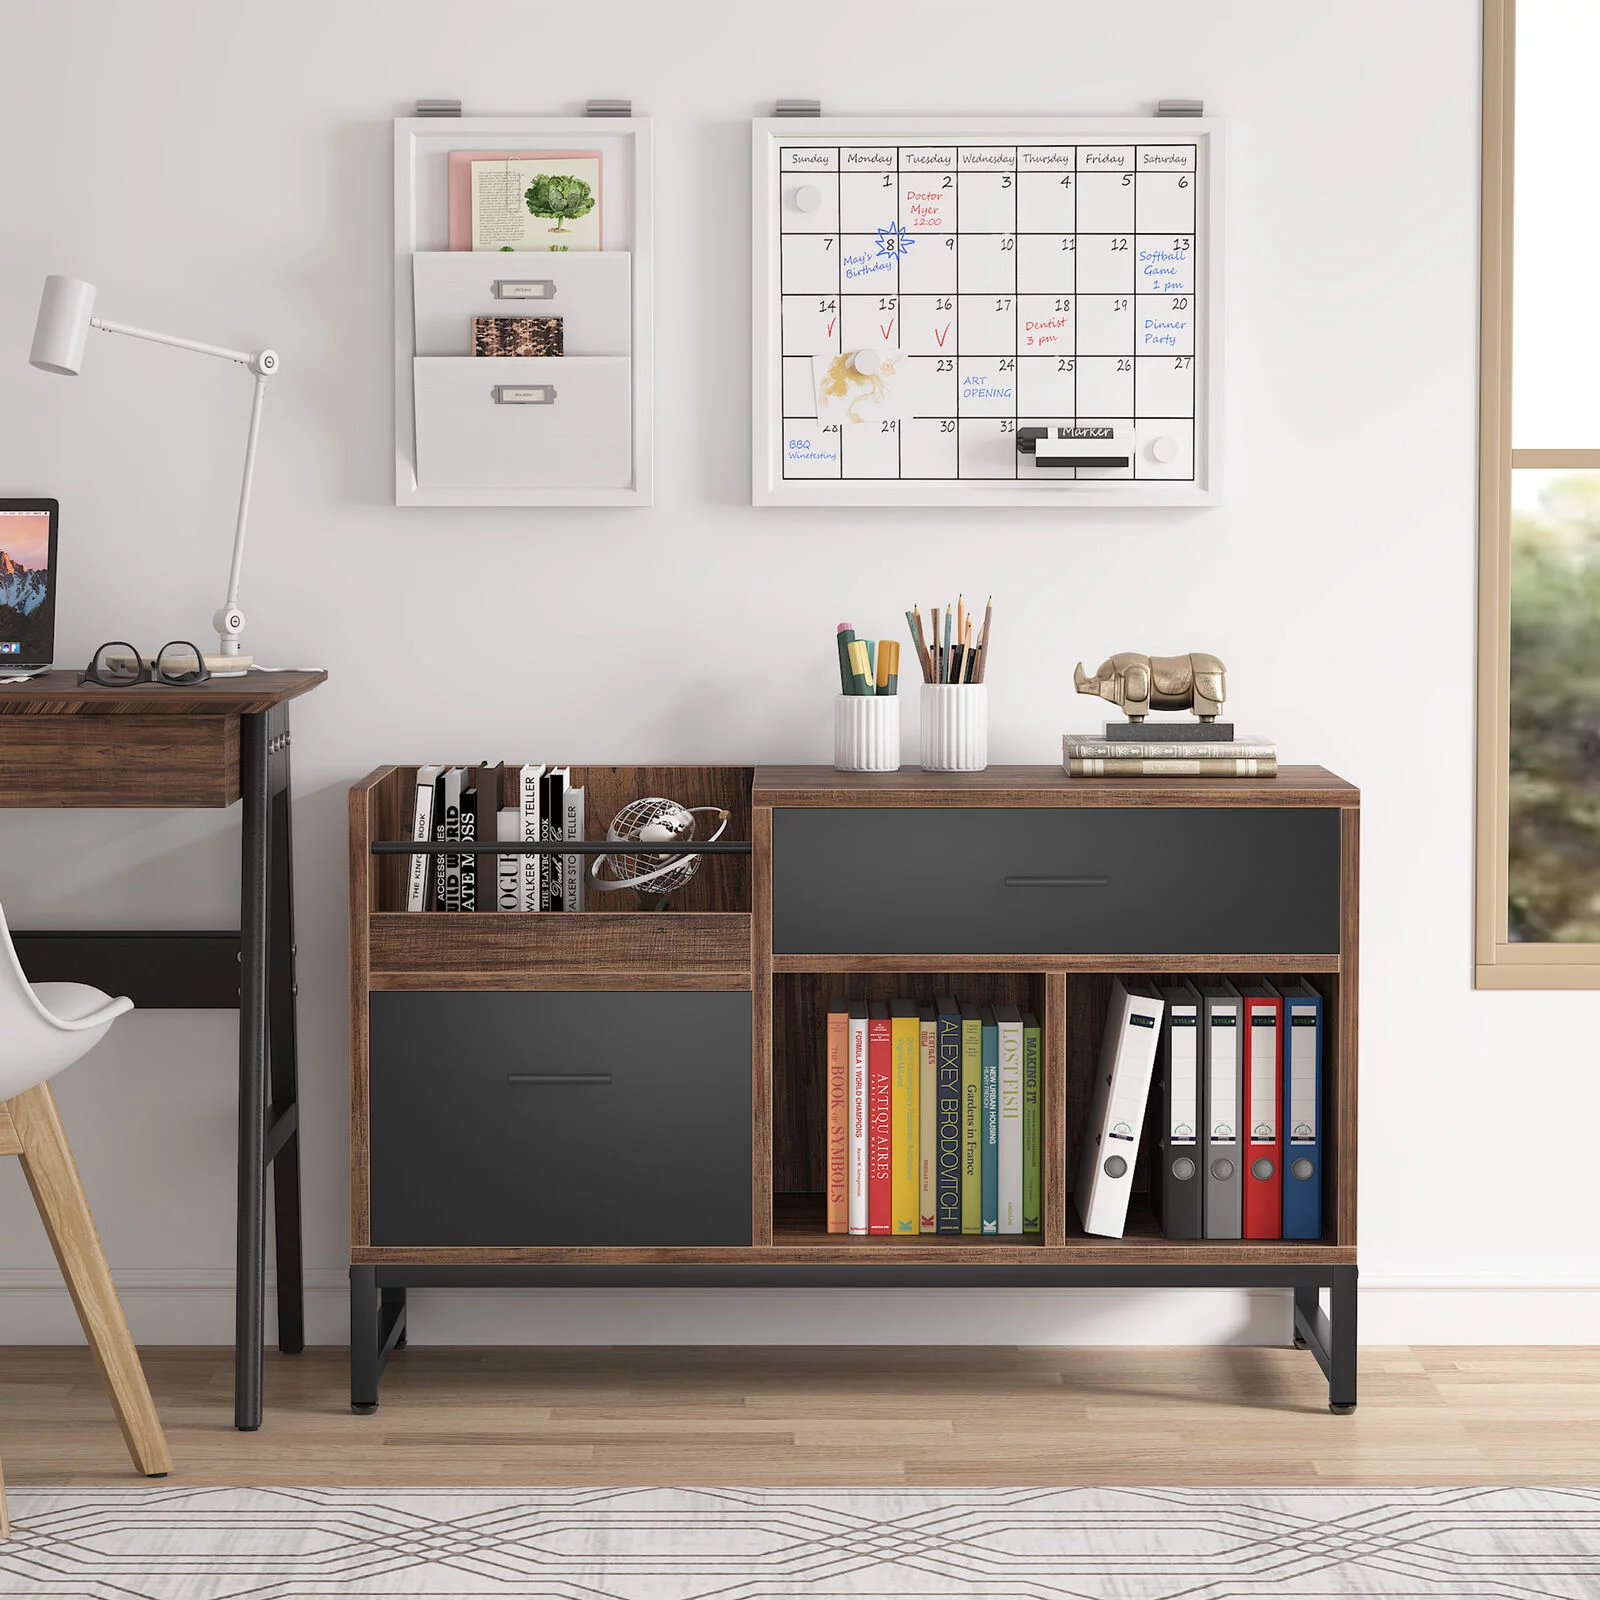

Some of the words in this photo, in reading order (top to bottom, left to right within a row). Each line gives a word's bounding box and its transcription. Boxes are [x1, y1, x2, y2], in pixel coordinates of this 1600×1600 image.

[792, 153, 829, 166] Sunday
[847, 154, 892, 166] Monday
[906, 154, 951, 166] Tuesday
[962, 153, 1015, 166] Wednesday
[1023, 153, 1069, 165] Thursday
[1085, 153, 1125, 166] Friday
[1143, 154, 1187, 165] Saturday
[882, 175, 892, 187] 1
[942, 176, 953, 188] 2
[1001, 176, 1012, 188] 3
[1060, 175, 1071, 188] 4
[1121, 175, 1132, 186] 5
[1178, 176, 1188, 188] 6
[907, 191, 943, 202] Doctor
[911, 204, 939, 217] Myer
[913, 218, 942, 226] 12:00
[824, 239, 833, 251] 7
[886, 239, 895, 251] 8
[945, 239, 954, 251] 9
[1001, 239, 1013, 252] 10
[1061, 239, 1076, 251] 11
[1111, 239, 1128, 251] 12
[1174, 239, 1190, 251] 13
[843, 252, 872, 267] May's
[1139, 251, 1186, 262] Softball
[846, 260, 892, 279] Birthday
[1144, 265, 1177, 277] Game
[1152, 280, 1160, 290] 1
[1164, 280, 1184, 291] pm
[819, 300, 836, 312] 14
[879, 299, 897, 311] 15
[936, 299, 952, 310] 16
[996, 300, 1011, 311] 17
[1055, 299, 1070, 311] 18
[1114, 299, 1128, 311] 19
[1172, 298, 1188, 310] 20
[1025, 318, 1066, 330] Dentist
[1145, 319, 1186, 330] Dinner
[1026, 335, 1034, 346] 3
[1037, 334, 1058, 346] pm
[1145, 333, 1176, 346] Party
[936, 360, 953, 372] 23
[999, 360, 1015, 372] 24
[1058, 360, 1074, 372] 25
[1117, 359, 1131, 373] 26
[1175, 357, 1191, 370] 27
[963, 377, 987, 386] ART
[963, 389, 1011, 398] OPENING
[881, 420, 896, 433] 29
[940, 420, 956, 433] 30
[1000, 420, 1015, 433] 31
[1062, 428, 1111, 437] Marker
[789, 440, 811, 450] BBQ
[526, 776, 535, 816] TELLER
[418, 813, 426, 838] BOOK
[568, 806, 576, 839] TELLER
[447, 806, 459, 867] WRLD
[526, 820, 535, 859] SORY
[541, 854, 549, 888] PLAYBO
[461, 872, 474, 911] ATE
[568, 877, 577, 911] ALKER
[541, 890, 549, 908] THE
[940, 1020, 958, 1095] ALEXEY
[1003, 1028, 1018, 1075] LOST
[1027, 1037, 1036, 1088] MAKING
[831, 1066, 844, 1108] BOOK
[1003, 1080, 1018, 1118] FISH
[1027, 1091, 1036, 1104] IT
[968, 1084, 977, 1126] Gardens
[877, 1074, 888, 1180] ANTIQUAIRES
[968, 1130, 976, 1138] in
[831, 1126, 844, 1203] SYMBOLS
[940, 1100, 958, 1220] BRODOVITCH
[968, 1142, 976, 1176] France
